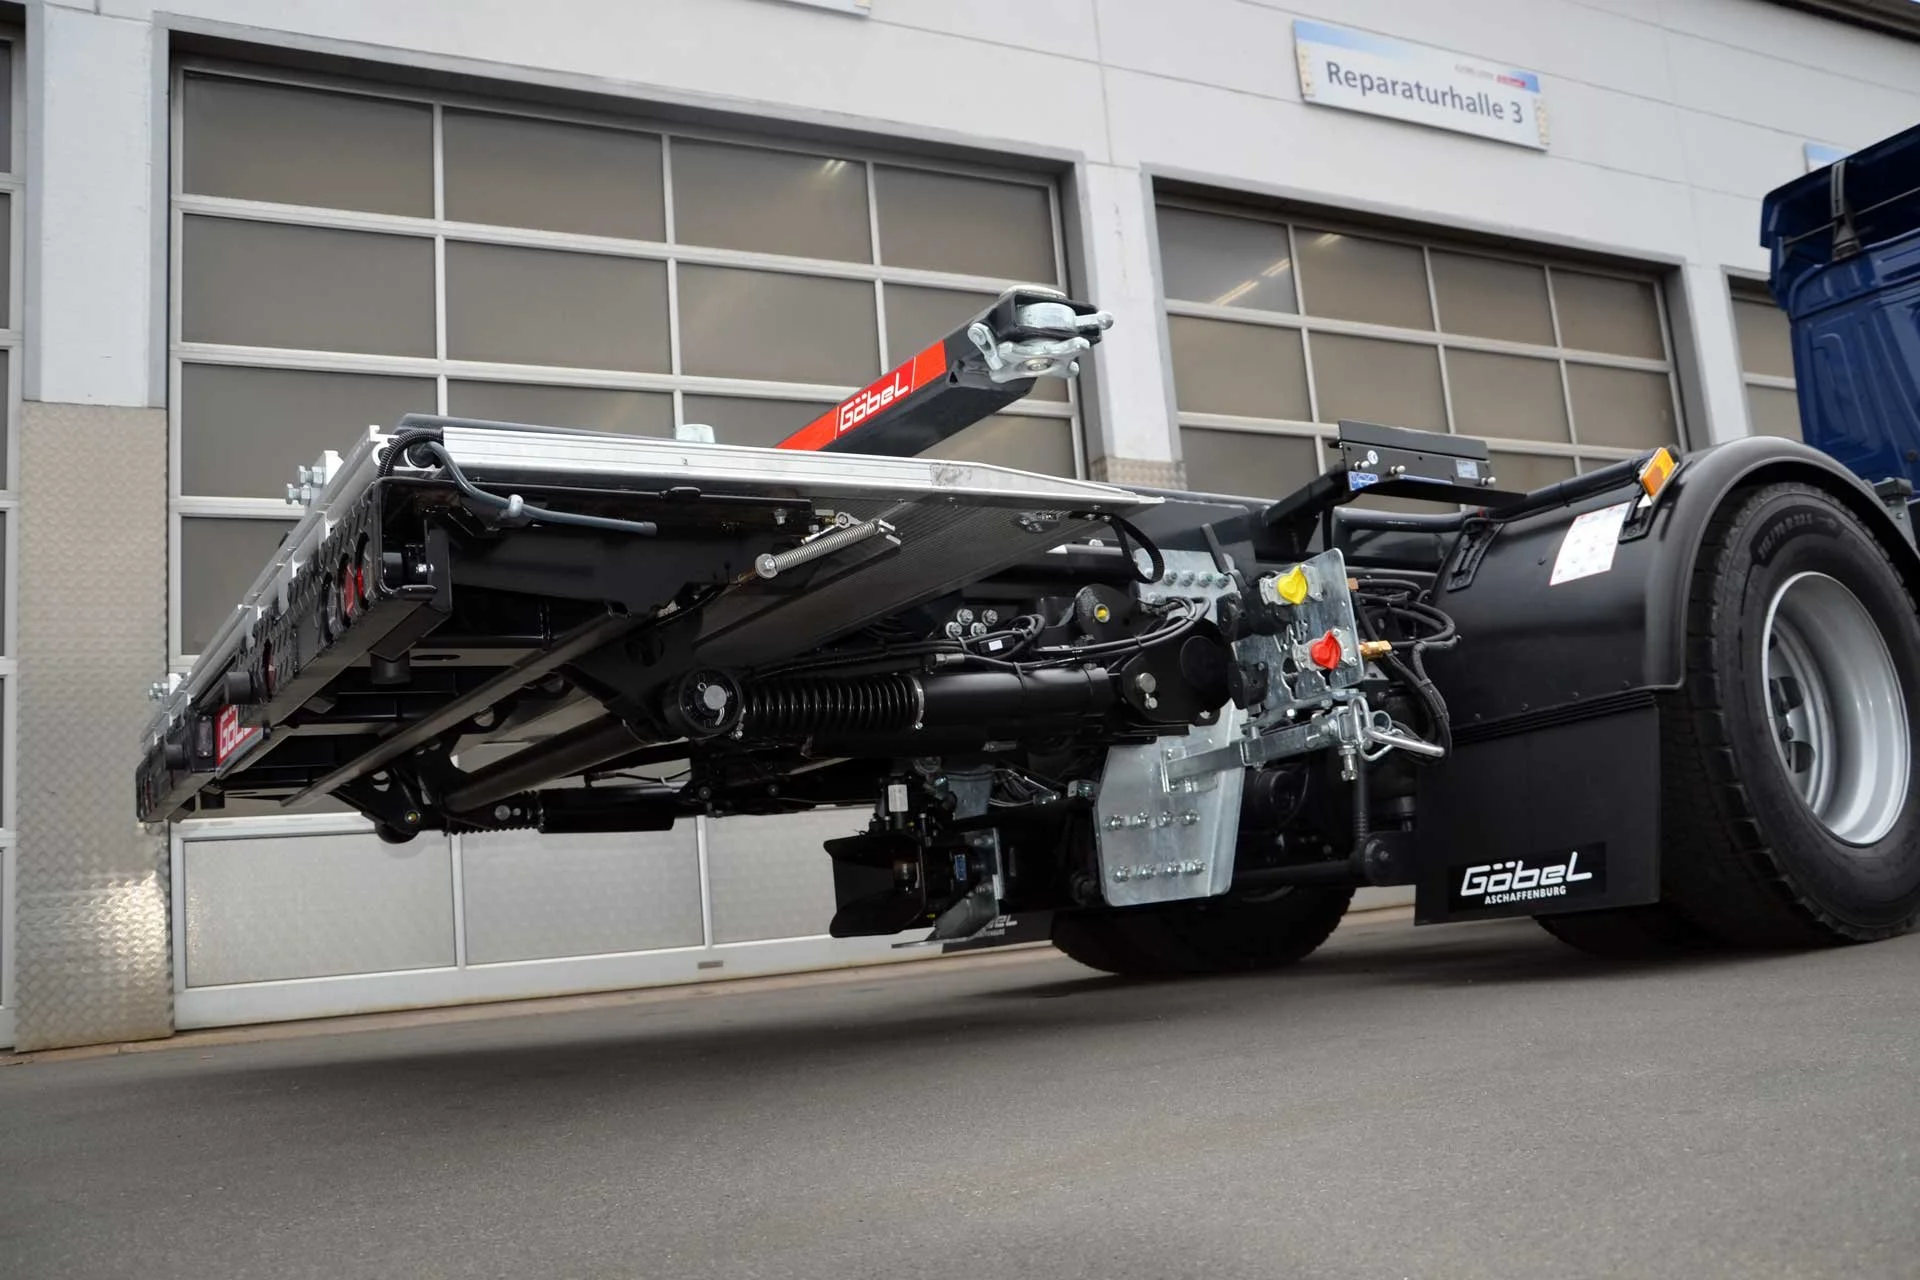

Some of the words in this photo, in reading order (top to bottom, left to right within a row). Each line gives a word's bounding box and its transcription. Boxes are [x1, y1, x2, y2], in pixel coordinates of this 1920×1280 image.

[1326, 61, 1504, 120] Reparaturhalle
[1511, 102, 1523, 124] 3
[1484, 885, 1567, 905] ASCHAFFENBURG
